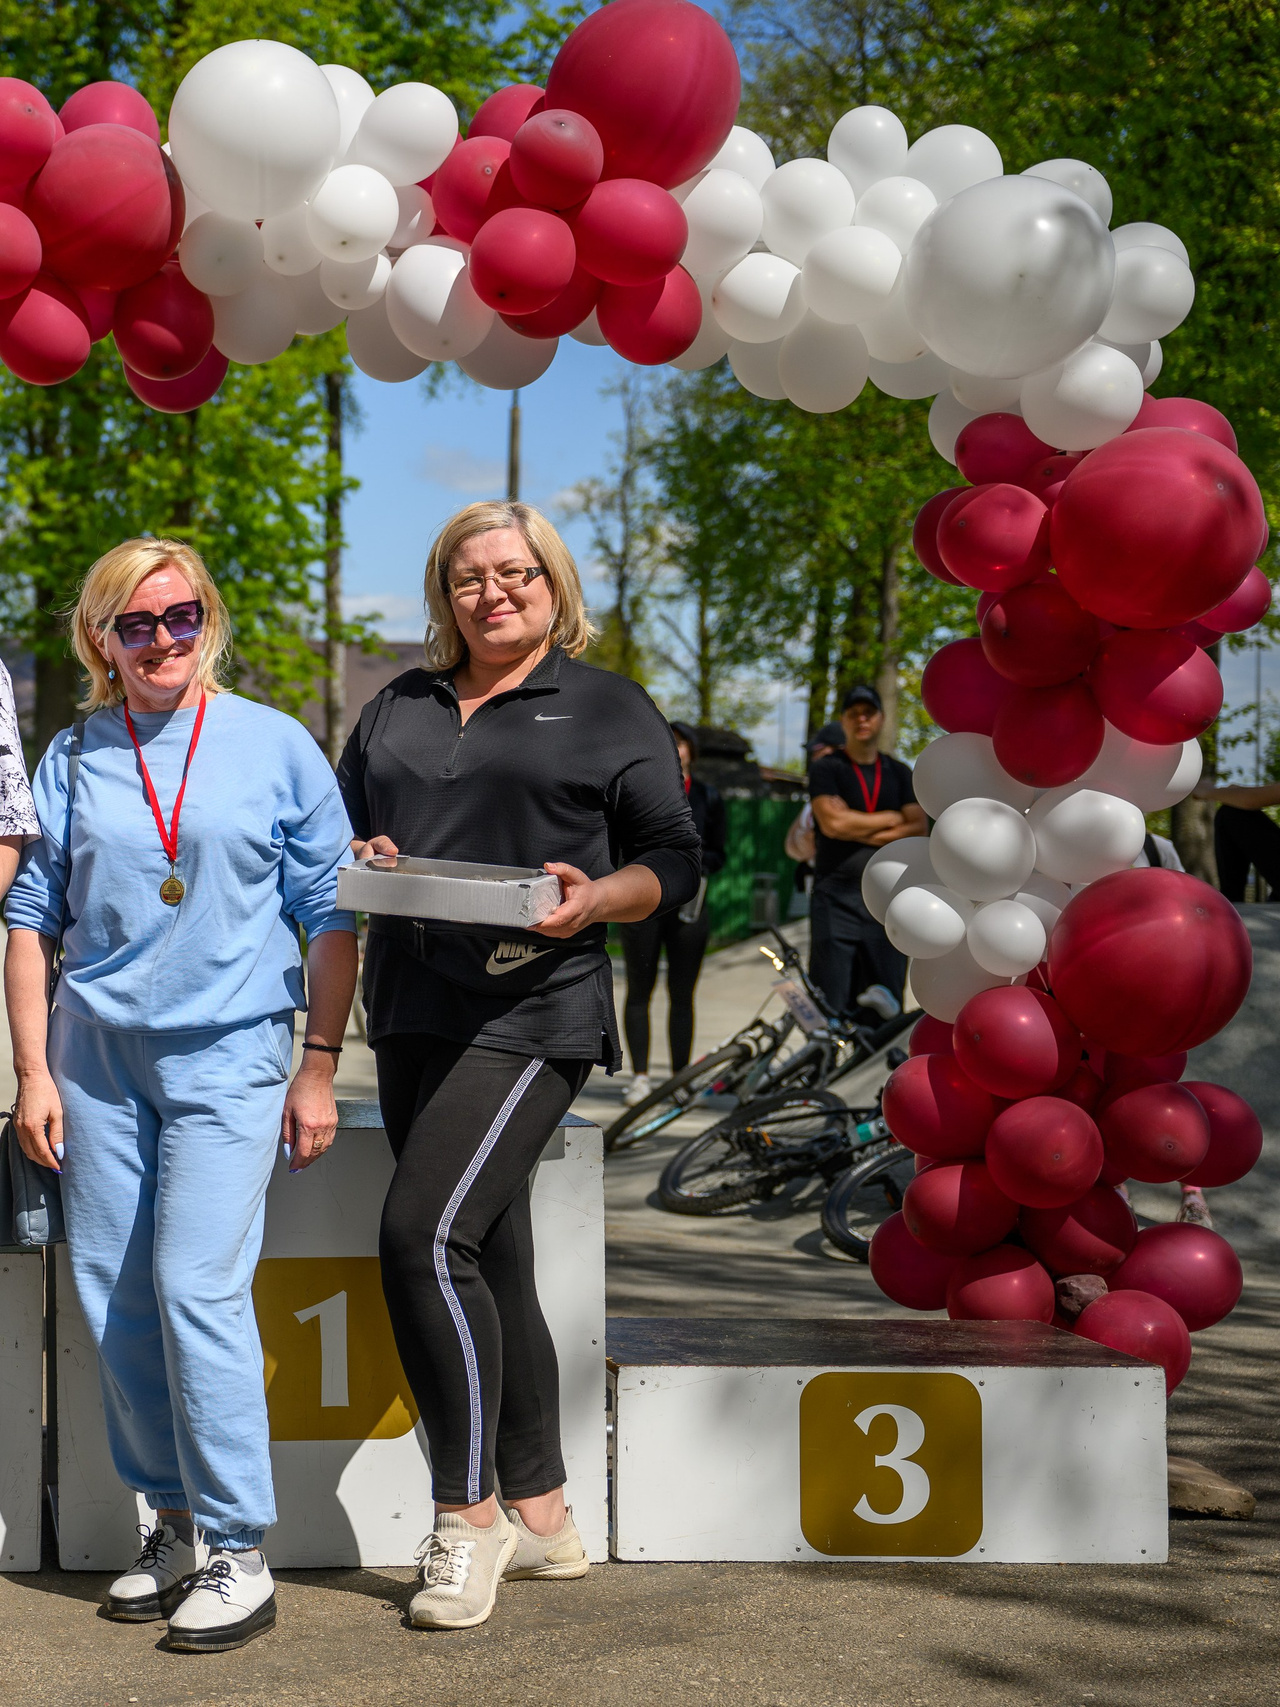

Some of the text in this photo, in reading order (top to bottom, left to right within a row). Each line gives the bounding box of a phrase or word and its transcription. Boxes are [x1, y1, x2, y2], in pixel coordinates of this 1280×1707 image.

[495, 941, 537, 959] NIKE
[293, 1290, 349, 1407] 1
[853, 1404, 931, 1524] 3
